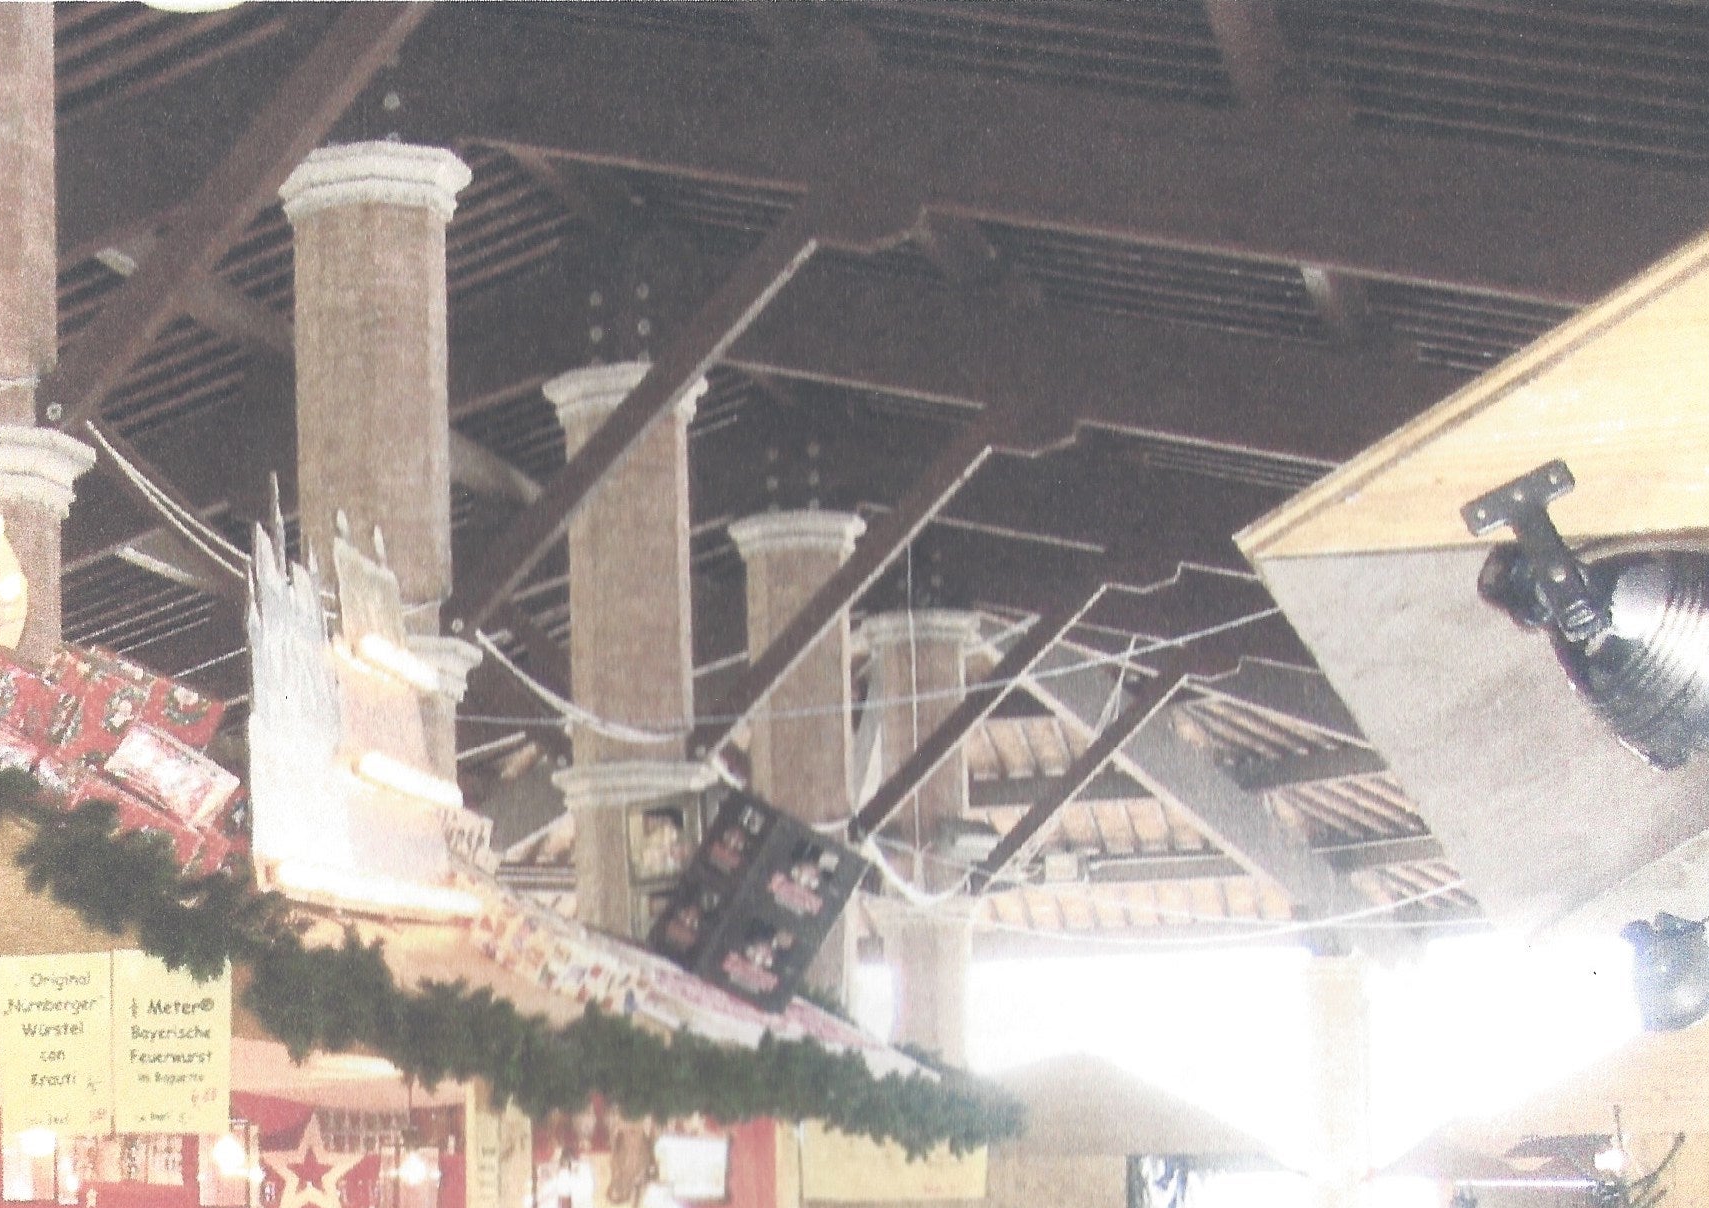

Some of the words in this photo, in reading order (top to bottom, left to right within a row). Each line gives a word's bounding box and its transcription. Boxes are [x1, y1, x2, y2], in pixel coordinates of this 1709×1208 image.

[29, 971, 92, 992] Original
[21, 1020, 85, 1038] Würstel
[129, 1023, 212, 1043] Bayerische
[39, 1048, 67, 1063] con
[129, 1048, 214, 1065] Feuerwurst
